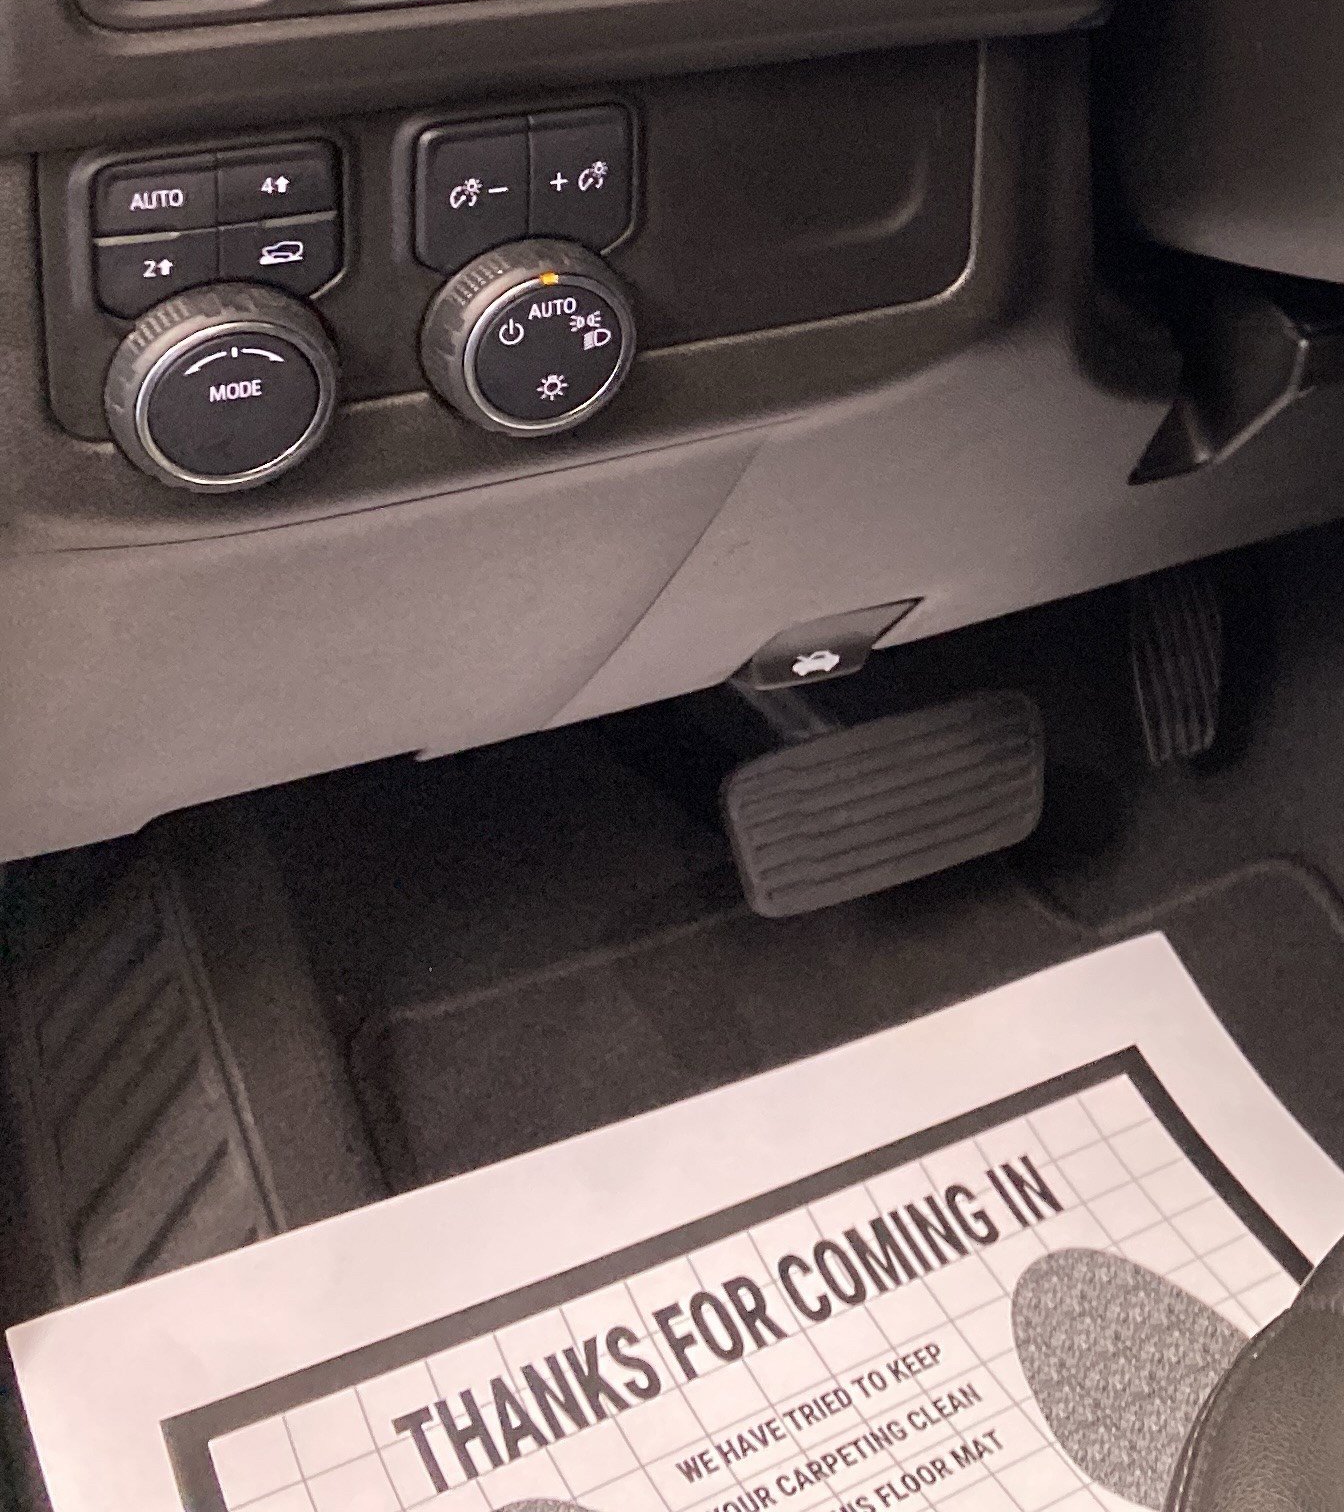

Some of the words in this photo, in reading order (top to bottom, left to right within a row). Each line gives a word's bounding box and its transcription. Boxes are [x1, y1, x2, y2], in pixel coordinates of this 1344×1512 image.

[129, 188, 185, 210] AUTO
[527, 296, 578, 321] AUTO
[208, 378, 264, 403] MODE
[391, 1325, 662, 1494] THANKS
[653, 1275, 788, 1381] FOR
[777, 1182, 1000, 1323] COMING
[985, 1154, 1065, 1228] IN
[675, 1448, 721, 1484] WE
[713, 1417, 788, 1465] HAVE
[783, 1386, 854, 1435] TRIED
[851, 1369, 888, 1401] TO
[885, 1342, 942, 1384] KEEP
[775, 1419, 909, 1497] CARPETING
[906, 1381, 985, 1431] CLEAN
[873, 1457, 954, 1510] FLOOR
[948, 1428, 1006, 1470] MAT
